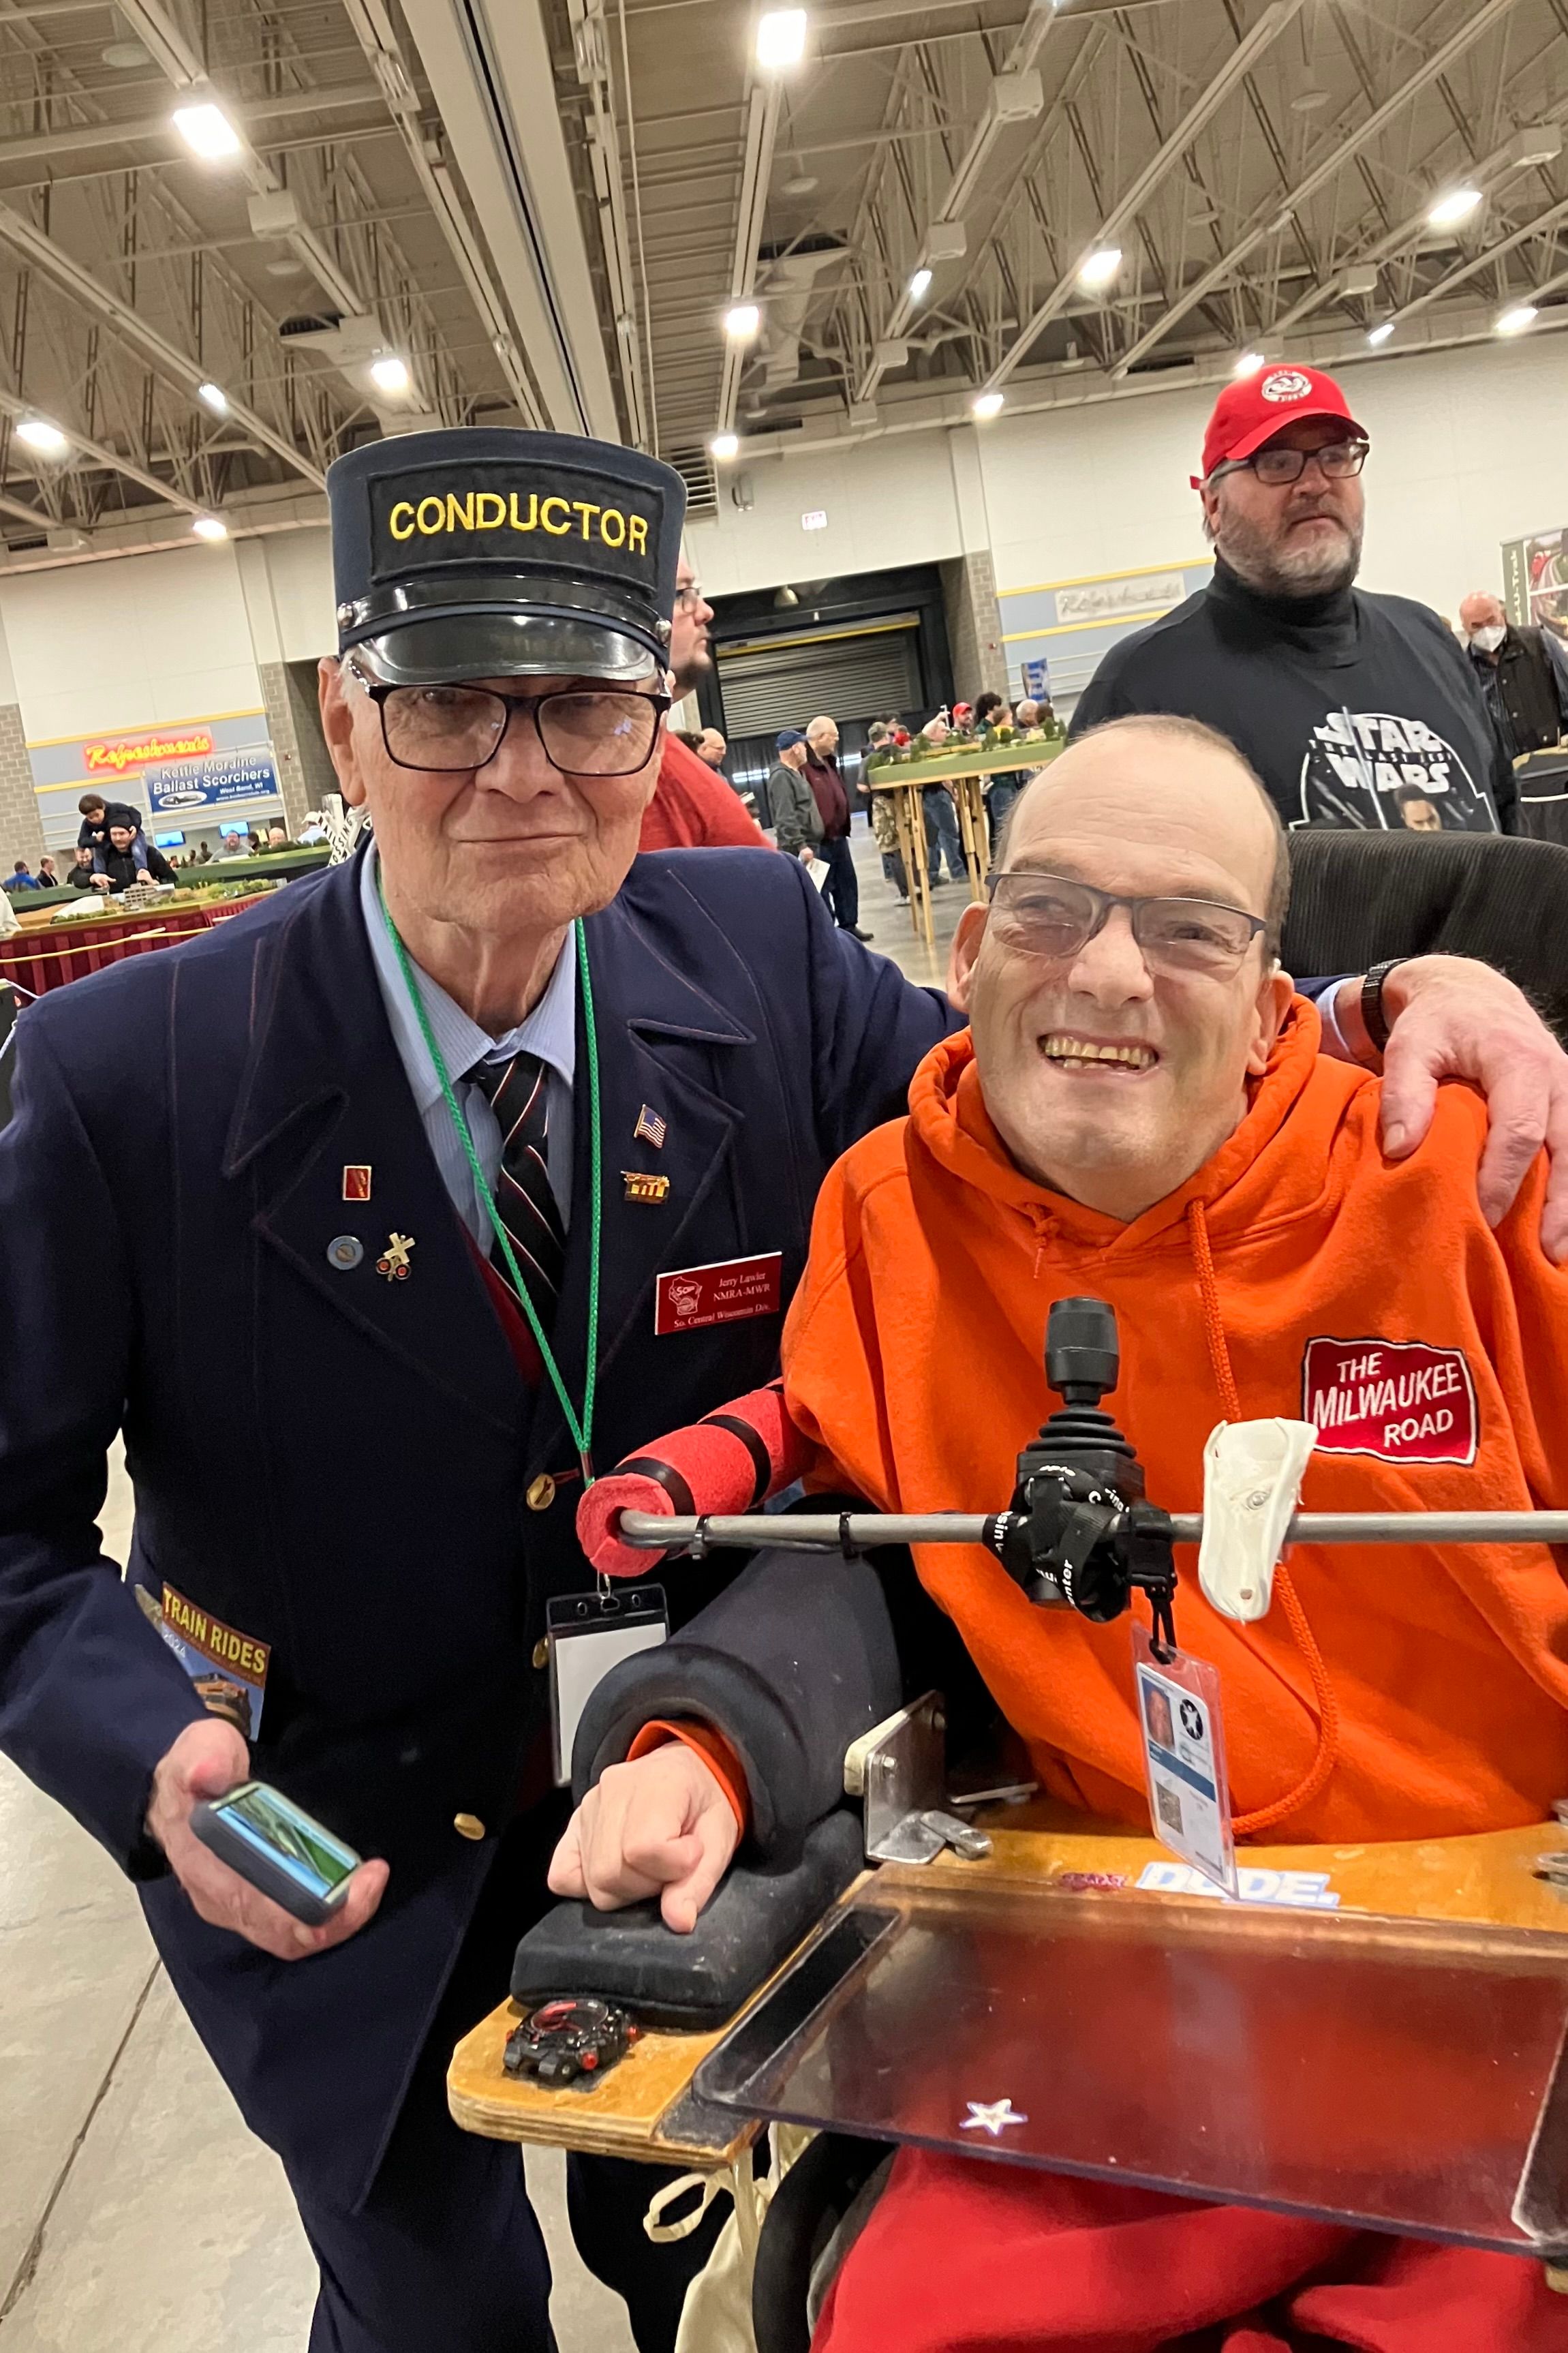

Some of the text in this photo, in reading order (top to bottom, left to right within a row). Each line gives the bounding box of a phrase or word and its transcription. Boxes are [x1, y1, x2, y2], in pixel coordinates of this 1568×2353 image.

[390, 492, 648, 556] CONDUCTOR
[1313, 712, 1443, 753] STAR
[153, 768, 270, 795] Ballast Scorchers
[161, 755, 257, 779] Kettle Moraine
[1325, 753, 1450, 793] WARS
[330, 818, 353, 866] OSSING
[713, 1284, 770, 1302] NMRA-MWR
[719, 1278, 738, 1287] Jerry
[688, 1313, 715, 1325] Central
[717, 1307, 754, 1319] Wisconsin
[1337, 1352, 1383, 1382] THE
[1313, 1363, 1462, 1429] MILWAUKEE
[1383, 1409, 1454, 1448] ROAD
[163, 1588, 265, 1673] TRAIN RIDES
